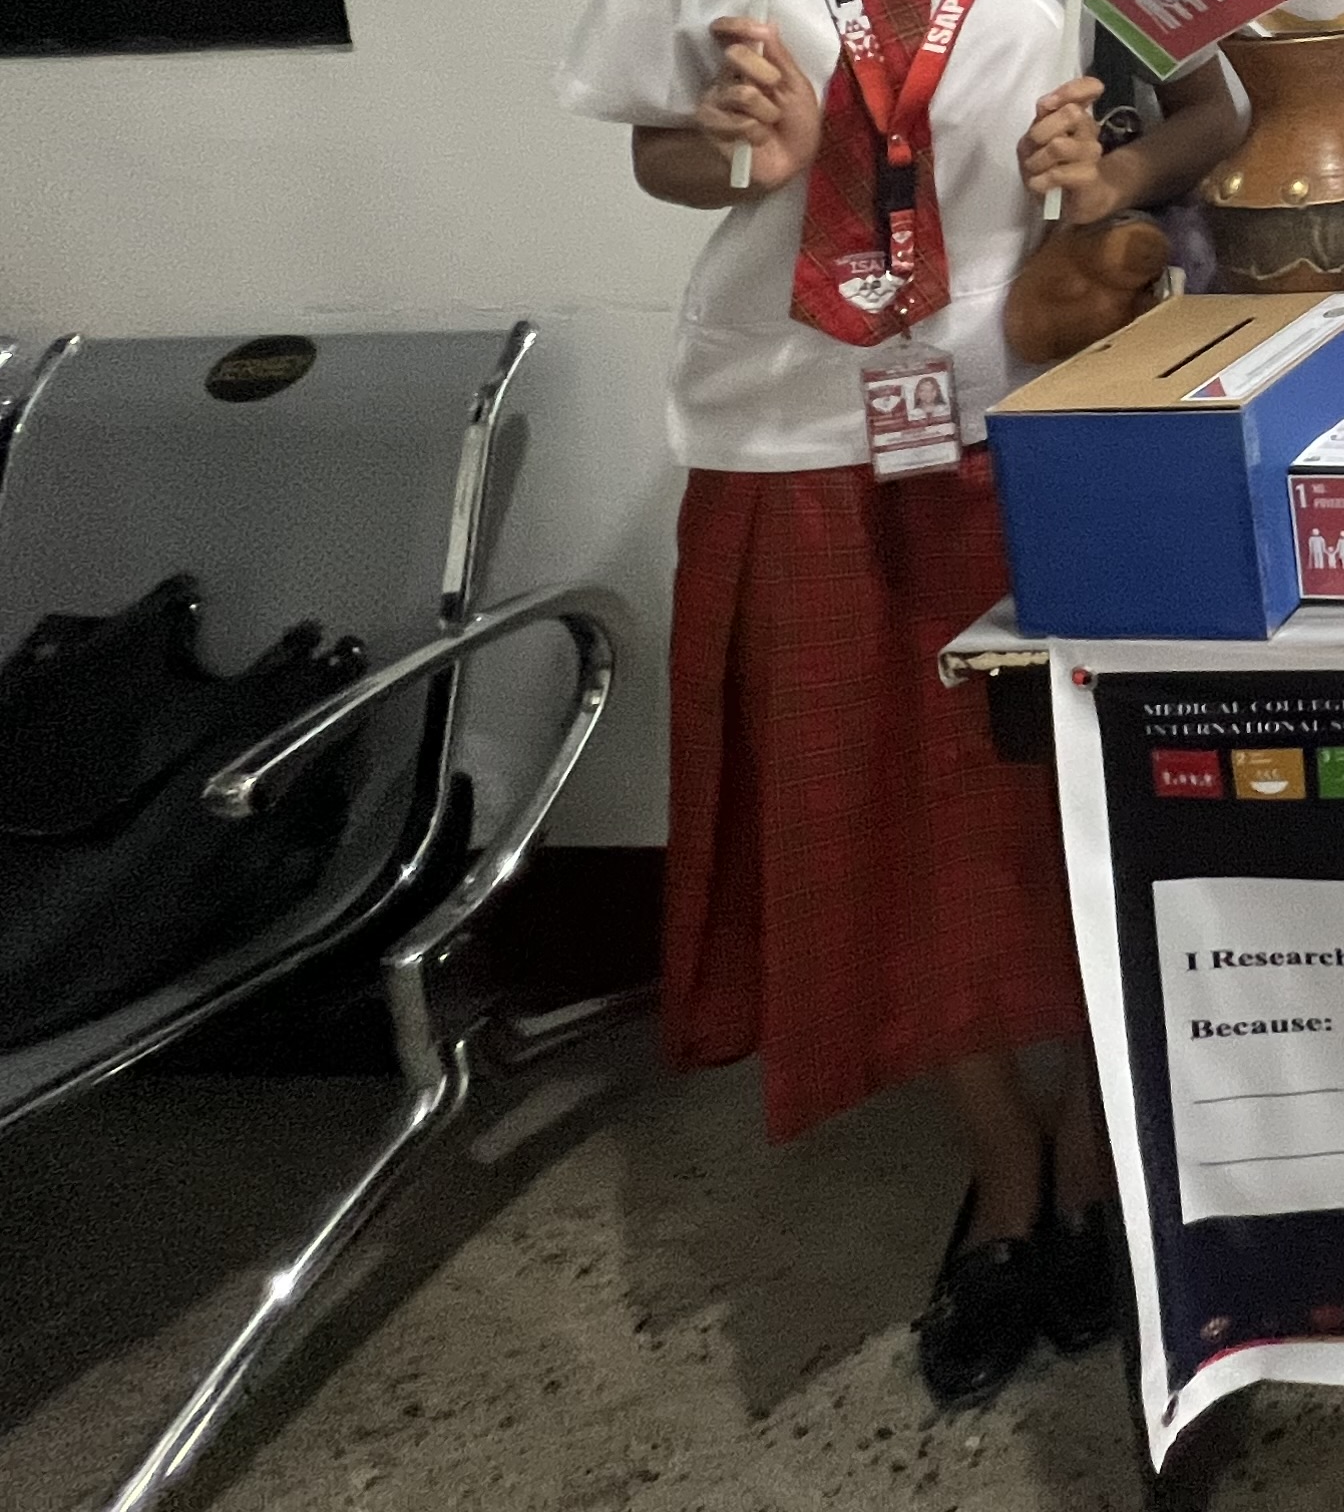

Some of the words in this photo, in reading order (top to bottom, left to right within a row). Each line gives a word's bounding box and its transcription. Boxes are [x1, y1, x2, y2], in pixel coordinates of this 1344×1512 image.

[850, 259, 885, 274] ISA
[1295, 484, 1308, 509] 1
[1236, 752, 1246, 765] 2
[1186, 952, 1198, 971] I
[1191, 1016, 1333, 1040] Because:
